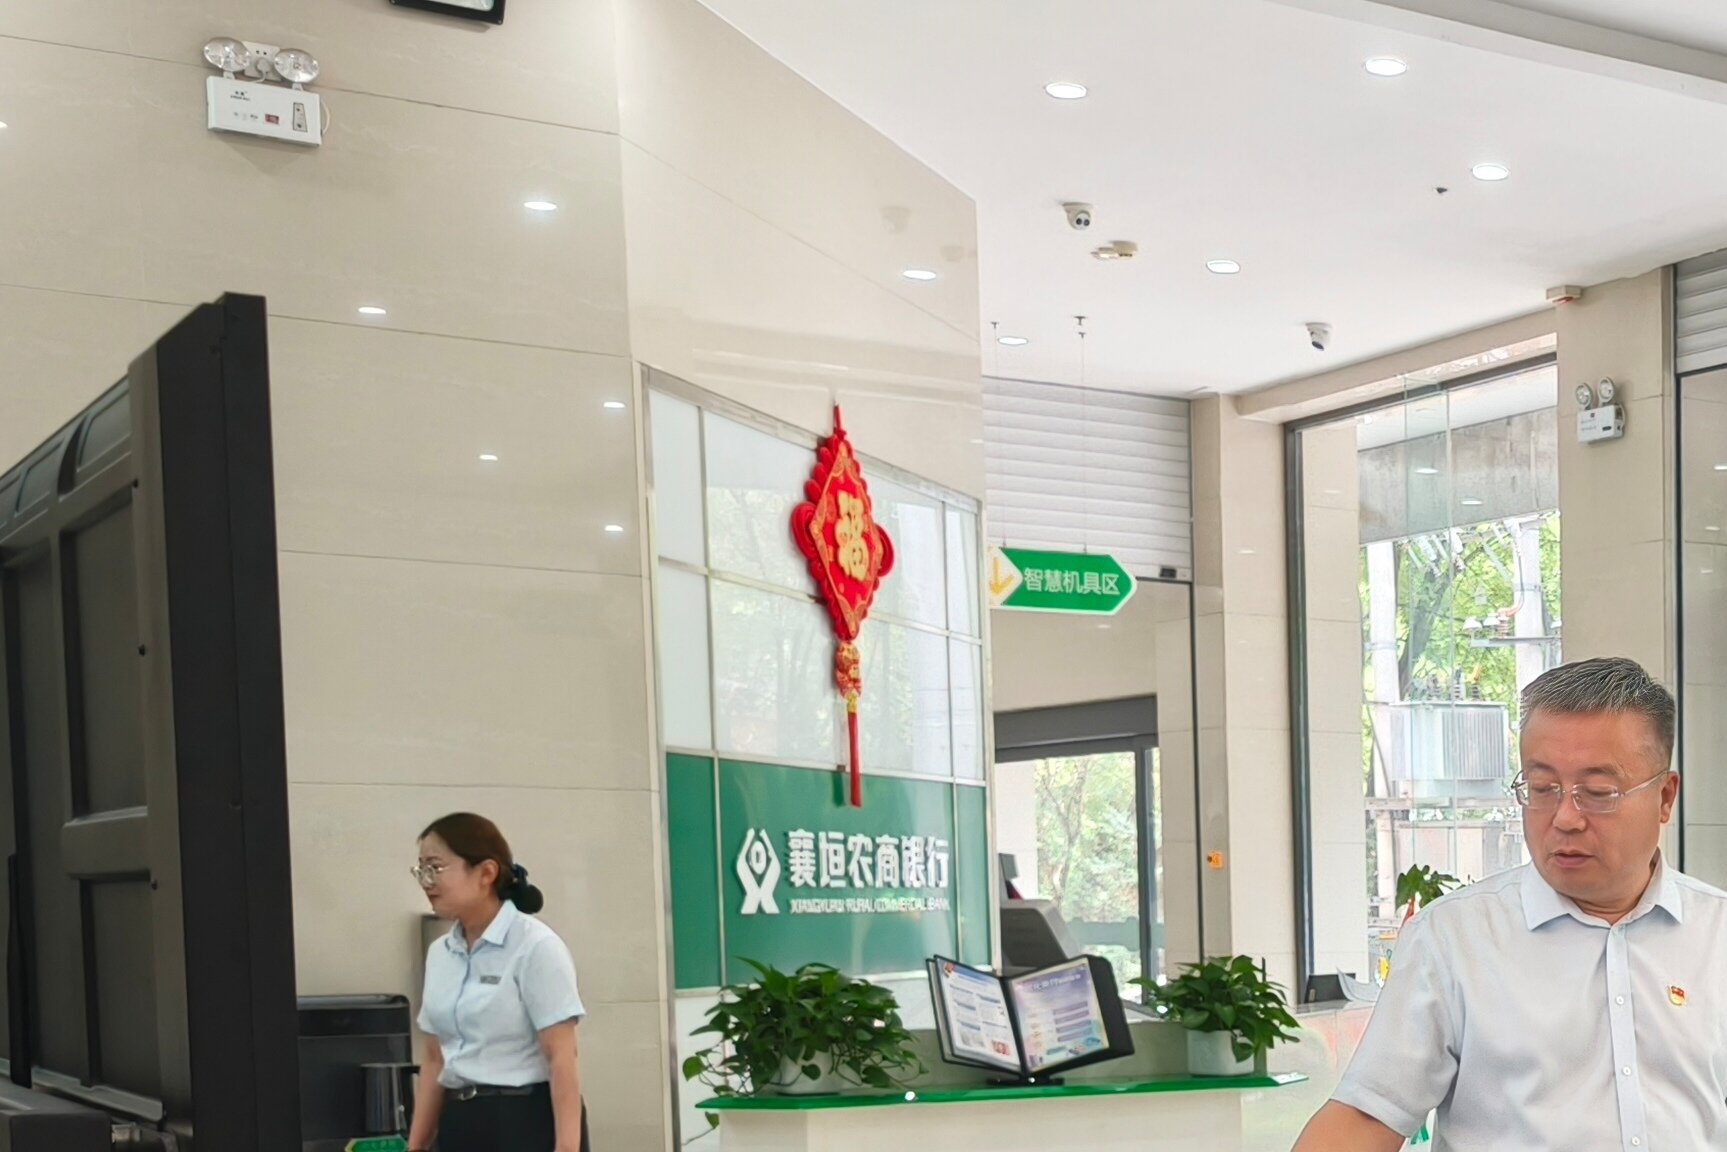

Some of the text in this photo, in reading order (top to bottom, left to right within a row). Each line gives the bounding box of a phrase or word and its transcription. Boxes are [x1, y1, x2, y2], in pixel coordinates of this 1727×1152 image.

[1023, 567, 1121, 596] 智慧机具区
[787, 828, 950, 889] 襄垣农商银行
